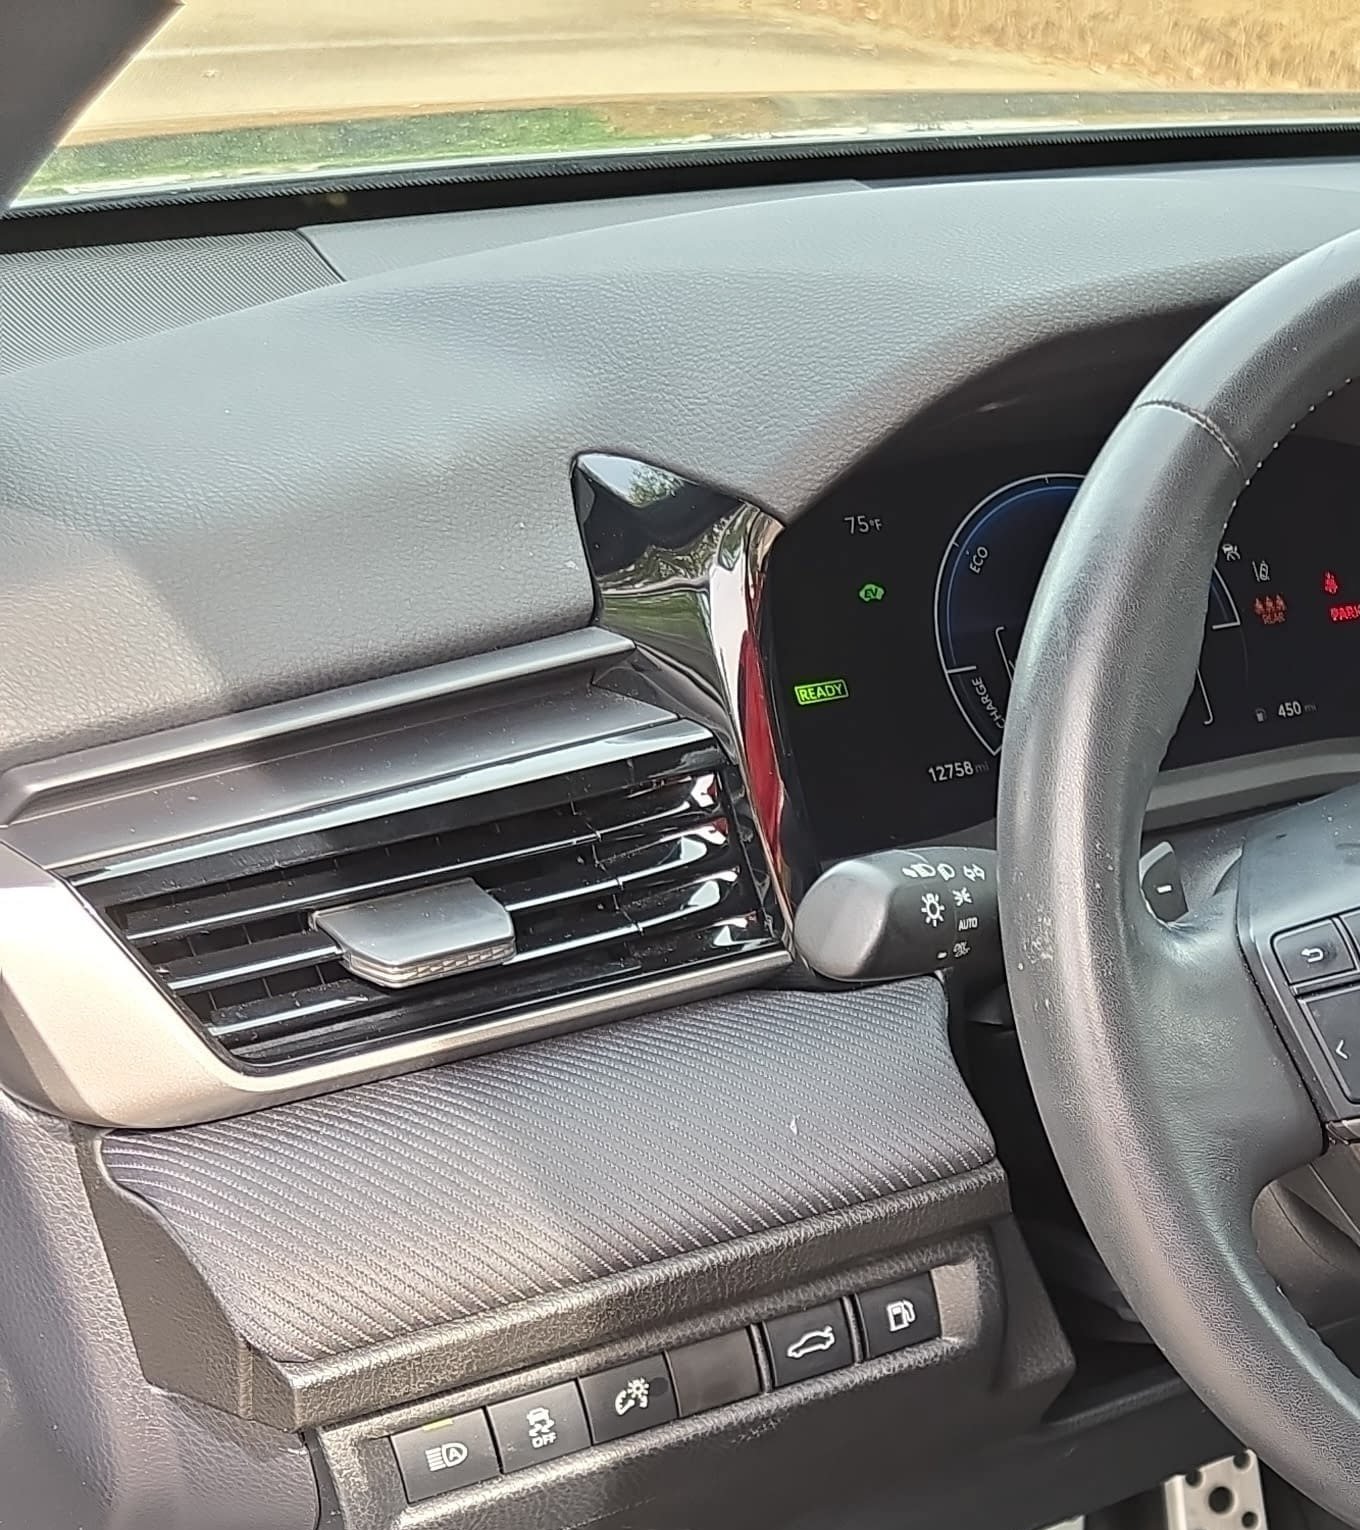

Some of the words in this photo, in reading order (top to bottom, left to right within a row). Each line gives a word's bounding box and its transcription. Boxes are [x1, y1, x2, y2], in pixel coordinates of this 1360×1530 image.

[969, 546, 988, 574] ECO
[799, 683, 842, 701] READY
[971, 676, 1006, 729] CHARGE
[1278, 700, 1302, 718] 450
[928, 760, 974, 782] 12758
[958, 917, 978, 931] AUTO
[532, 1432, 557, 1449] OFF
